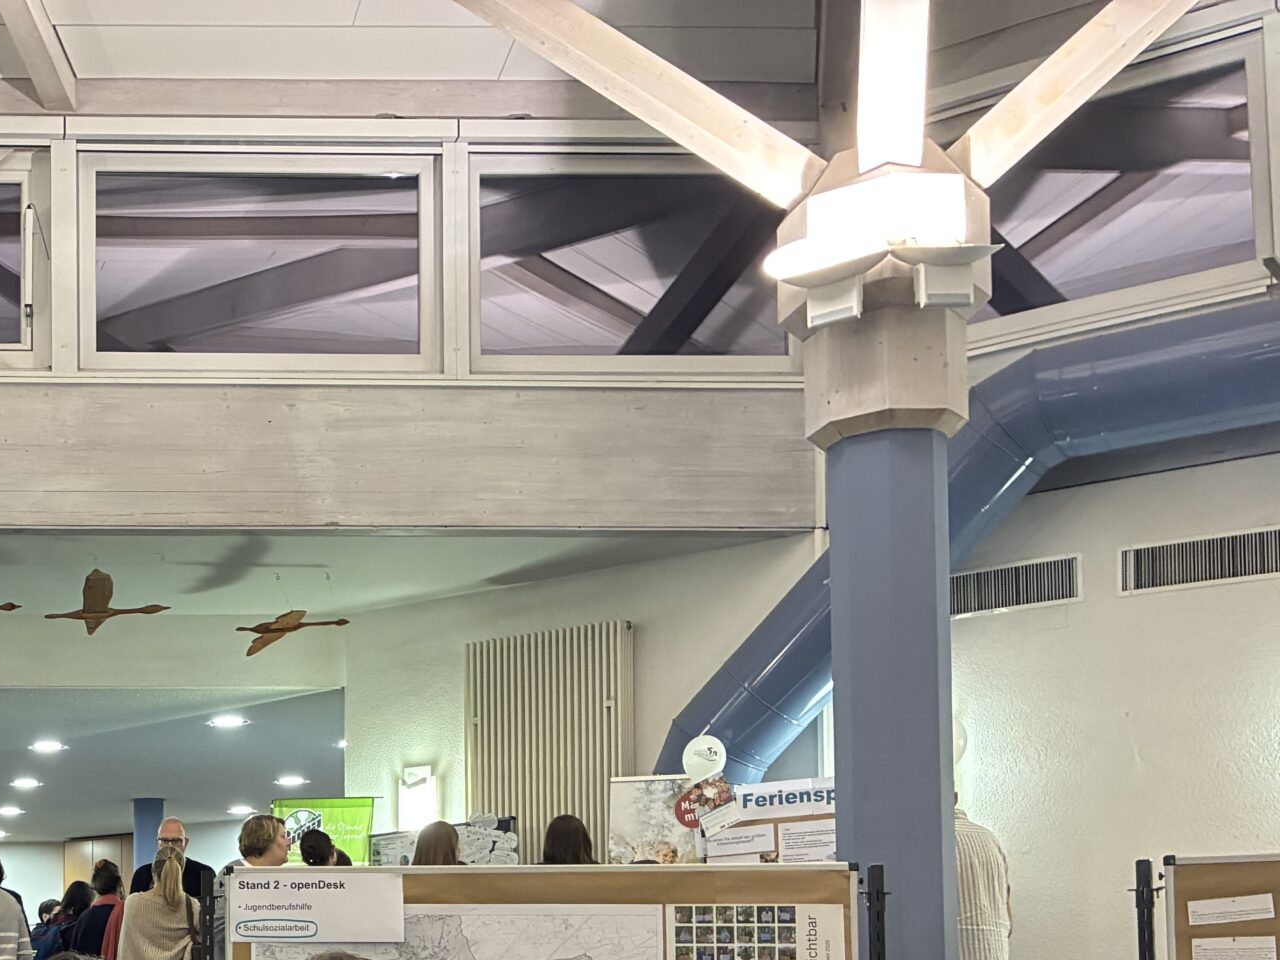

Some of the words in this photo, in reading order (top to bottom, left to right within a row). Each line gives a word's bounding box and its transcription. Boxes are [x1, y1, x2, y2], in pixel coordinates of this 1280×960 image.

[742, 788, 835, 809] Feriensp
[681, 800, 696, 811] Ma
[684, 810, 698, 821] mi
[238, 880, 270, 890] Stand
[273, 880, 280, 890] 2
[290, 880, 346, 892] openDesk
[243, 903, 312, 912] Jugendberufshilfe
[243, 924, 310, 932] Schulsozialarbeit
